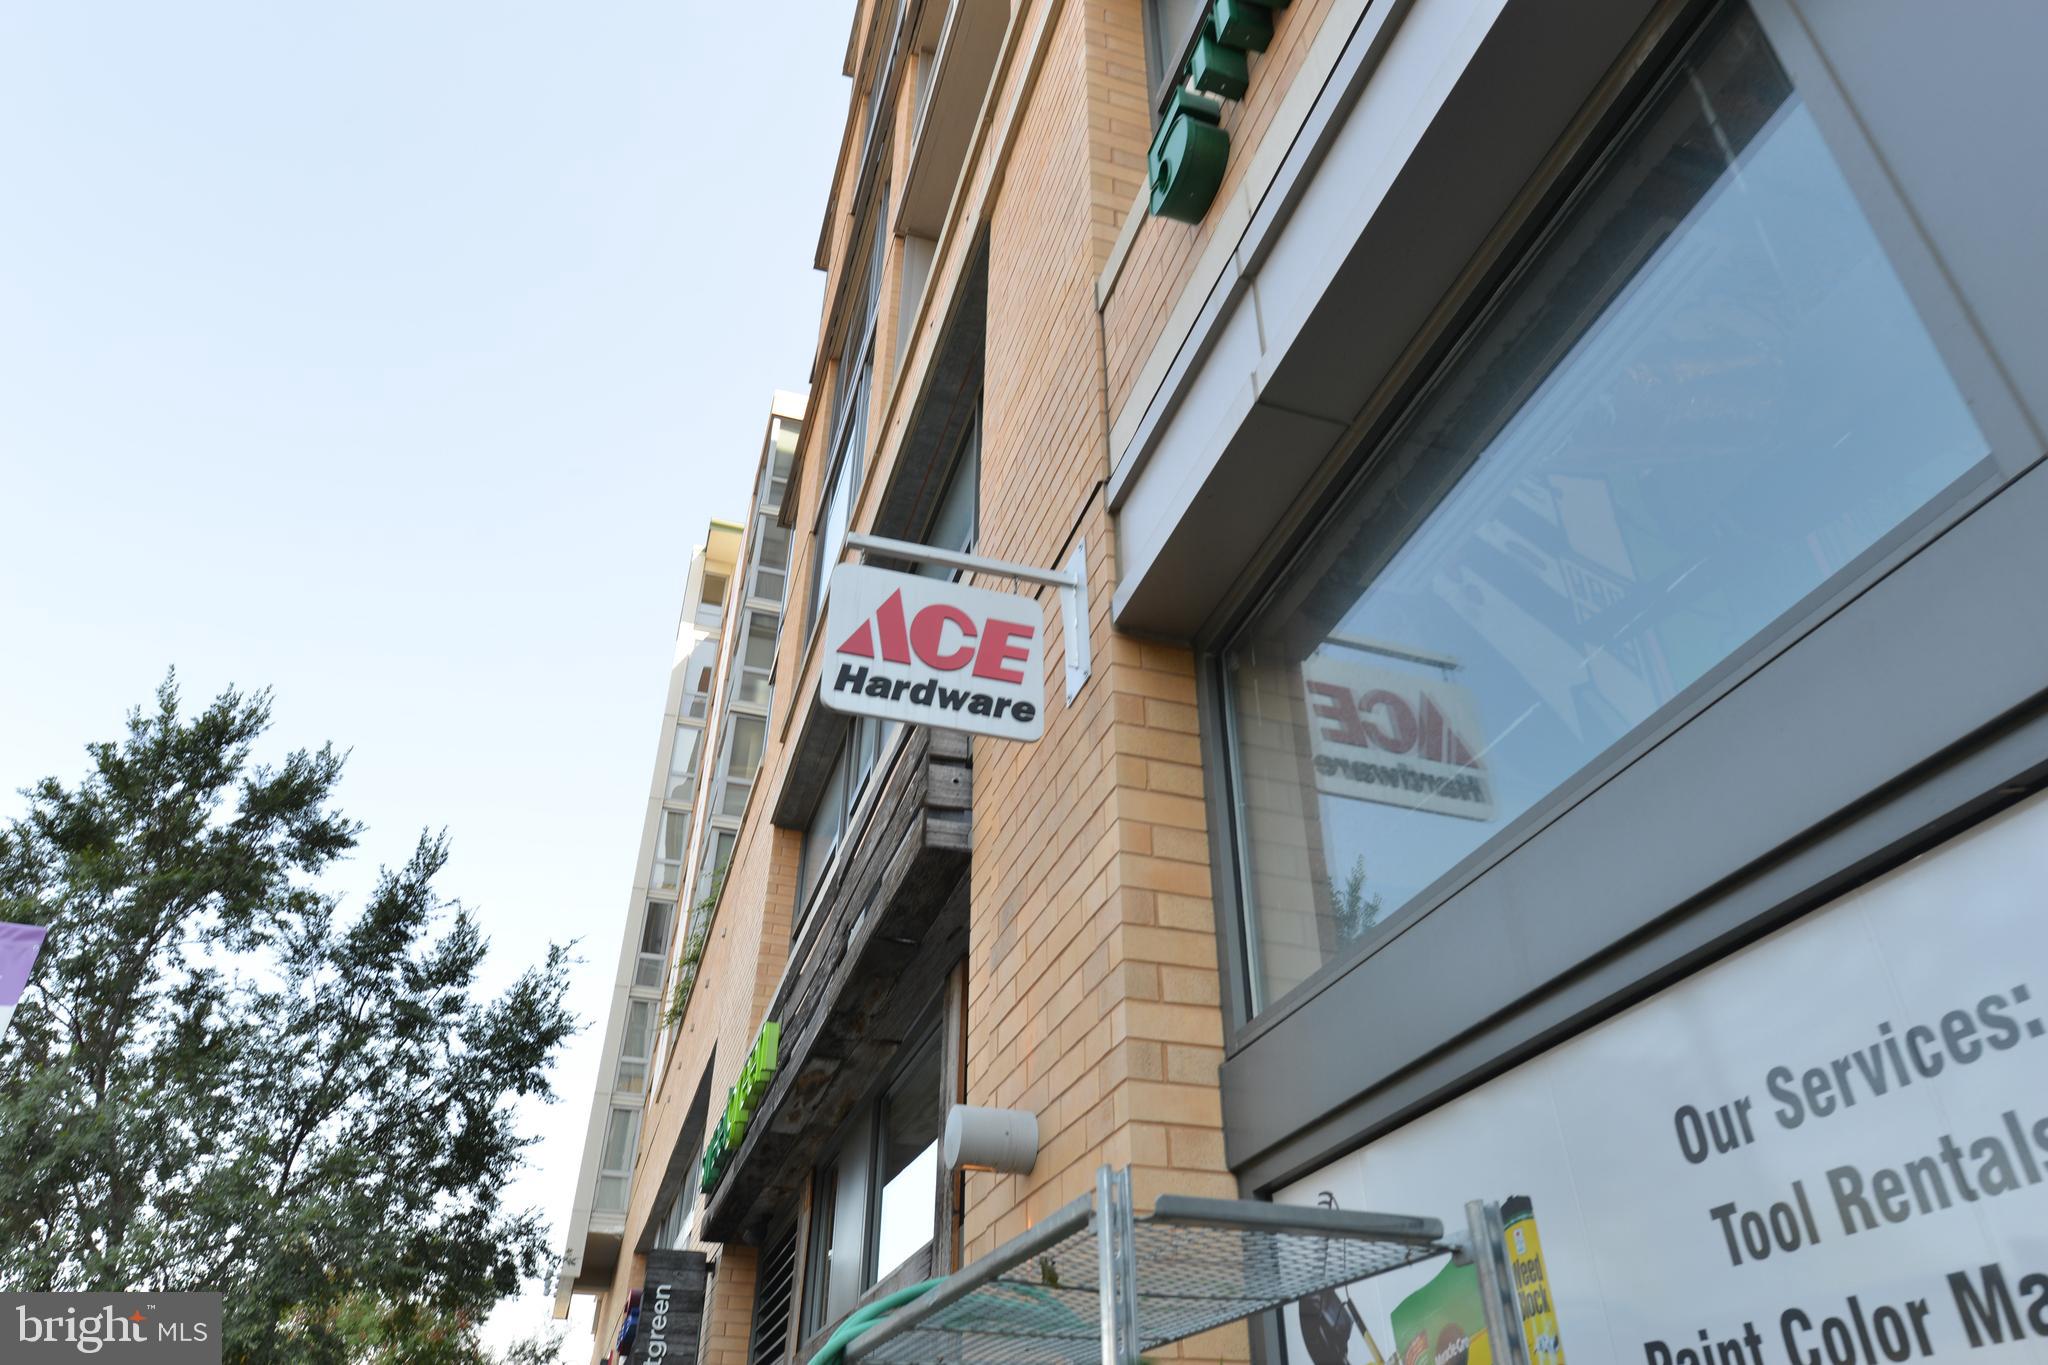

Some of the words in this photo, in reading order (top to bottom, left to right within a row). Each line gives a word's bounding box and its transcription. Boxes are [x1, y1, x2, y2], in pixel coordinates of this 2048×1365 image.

[836, 587, 1035, 685] ACE
[833, 663, 1036, 723] Hardware
[1674, 1095, 1755, 1164] Our
[1766, 984, 2046, 1130] Services:
[1709, 1180, 1822, 1267] Tool
[1780, 1295, 1935, 1365] Color
